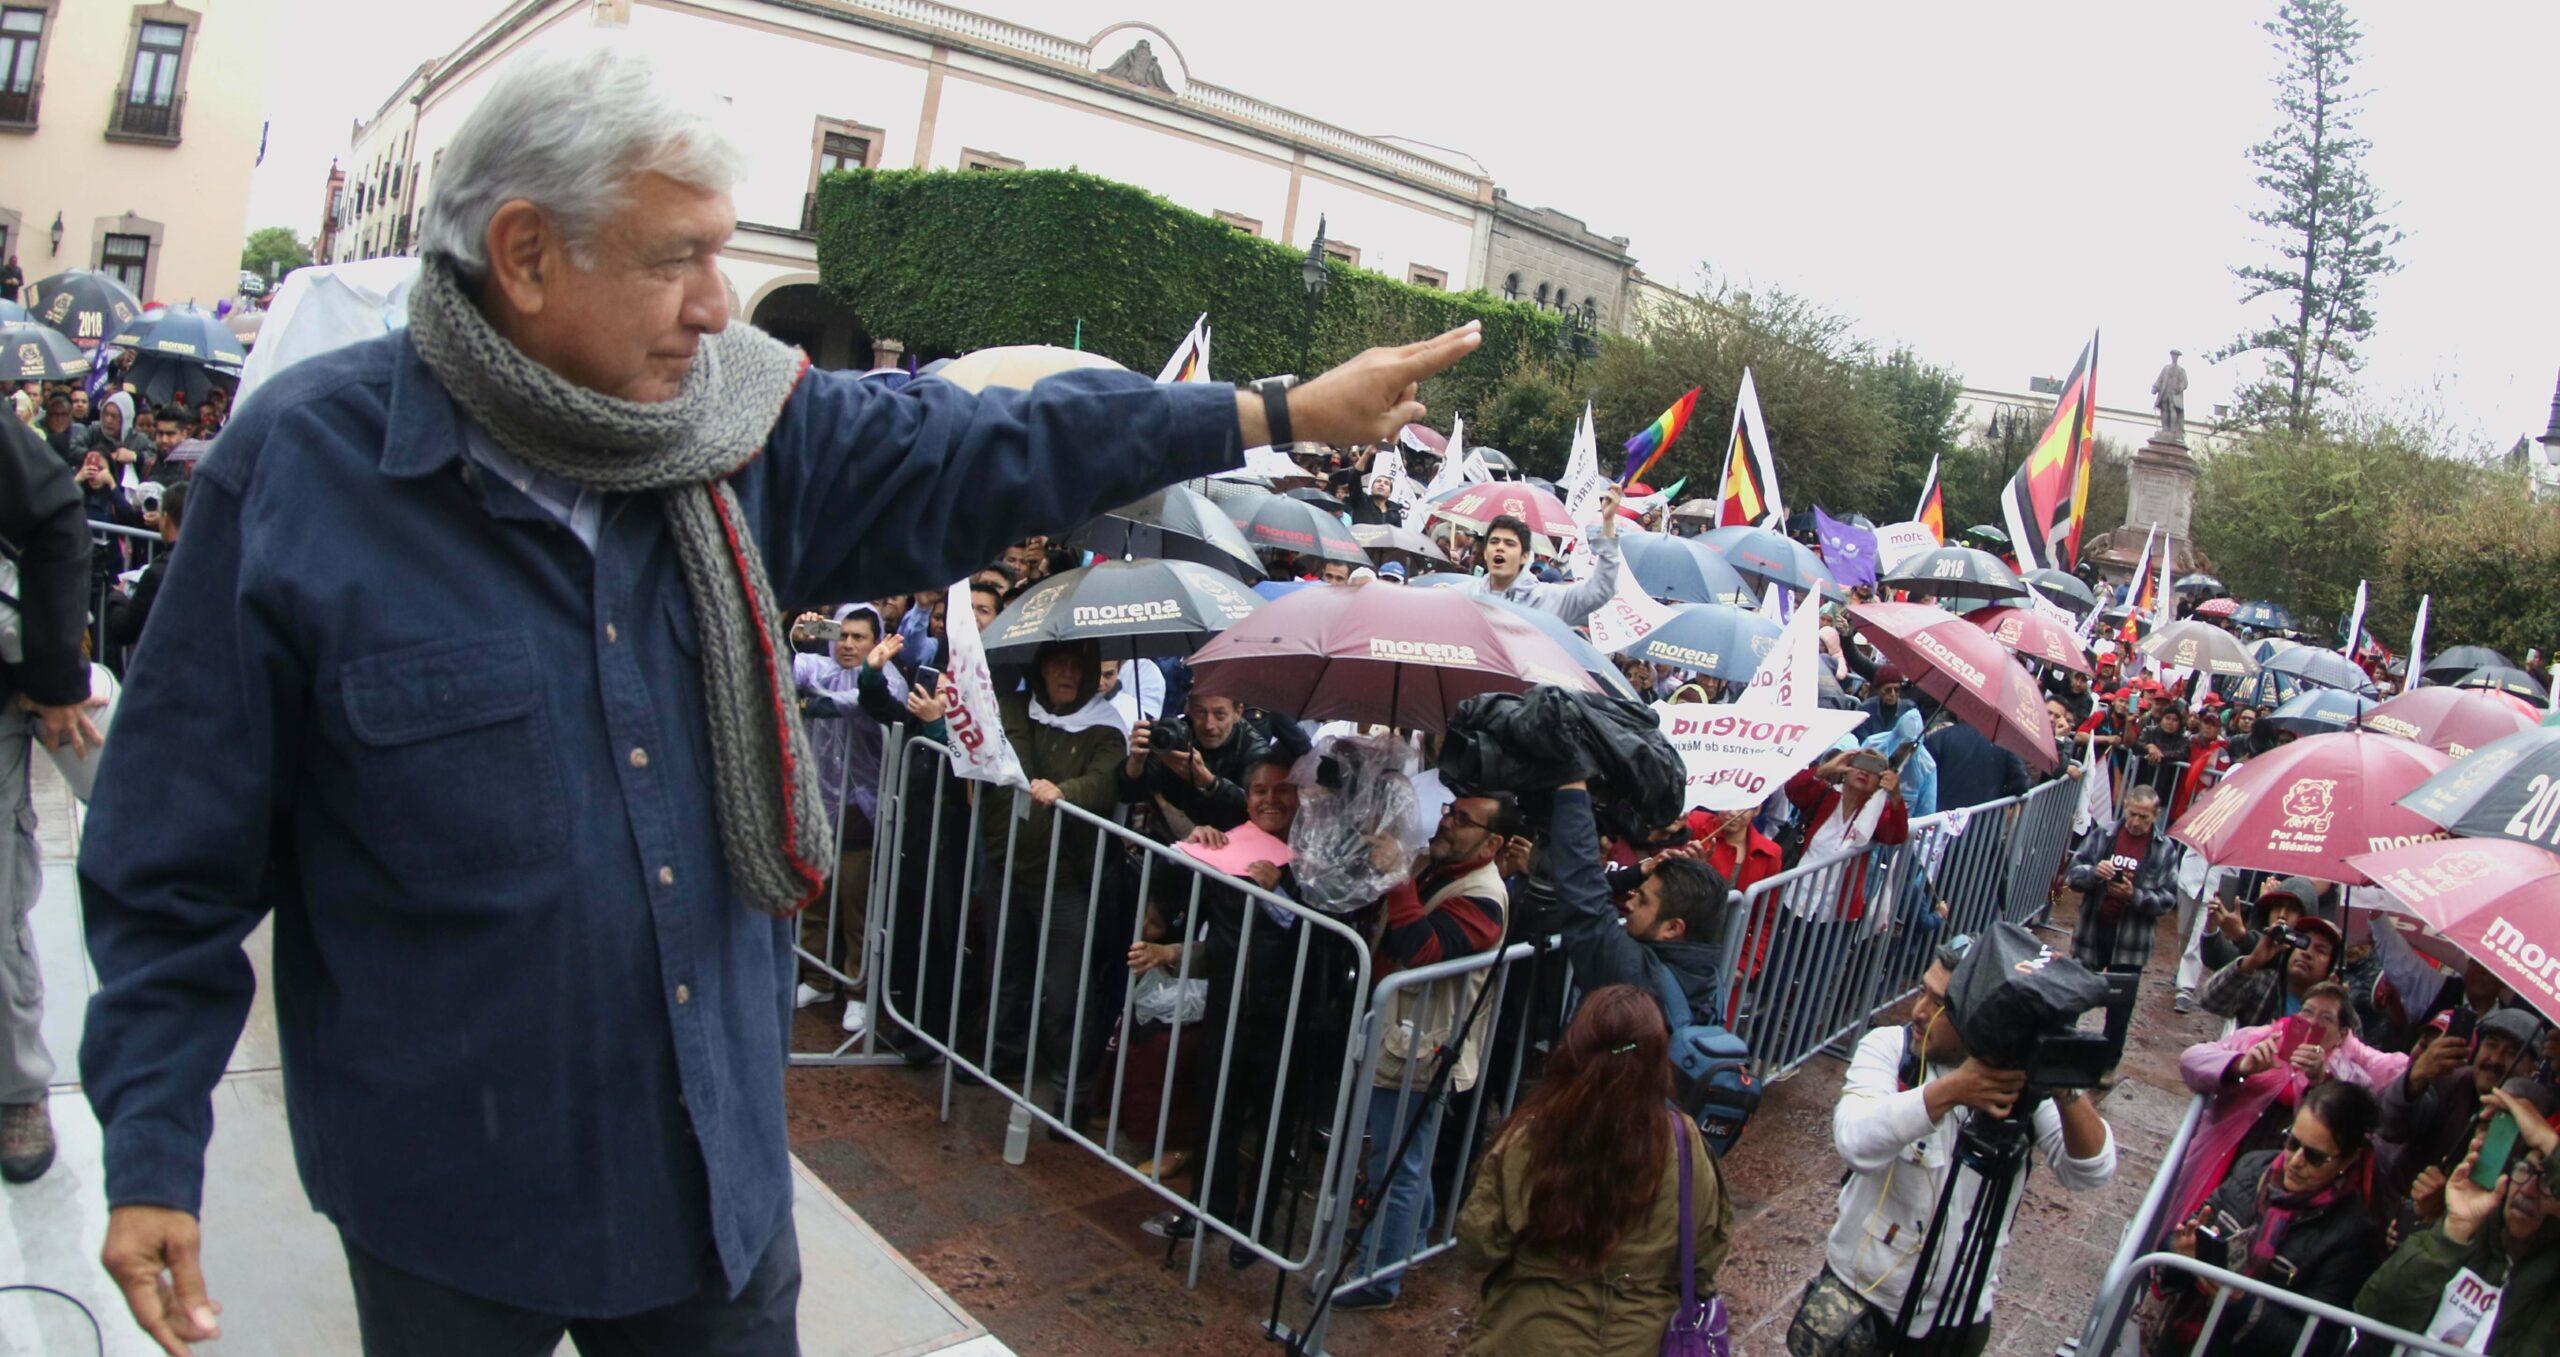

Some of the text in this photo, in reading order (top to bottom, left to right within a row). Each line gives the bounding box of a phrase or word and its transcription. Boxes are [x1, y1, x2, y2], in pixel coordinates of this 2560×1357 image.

[79, 311, 103, 337] 2018
[1255, 523, 1314, 543] morena
[1933, 559, 1965, 578] 2018
[1073, 598, 1180, 620] morena
[1370, 638, 1477, 660] morena
[1648, 639, 1719, 665] morena
[1914, 631, 1986, 685] morena
[2373, 715, 2422, 739] morena
[2184, 783, 2250, 844] 2018
[2268, 840, 2323, 853] a México
[2271, 829, 2327, 842] Por Amor
[2481, 934, 2496, 951] La
[2487, 915, 2560, 989] mor
